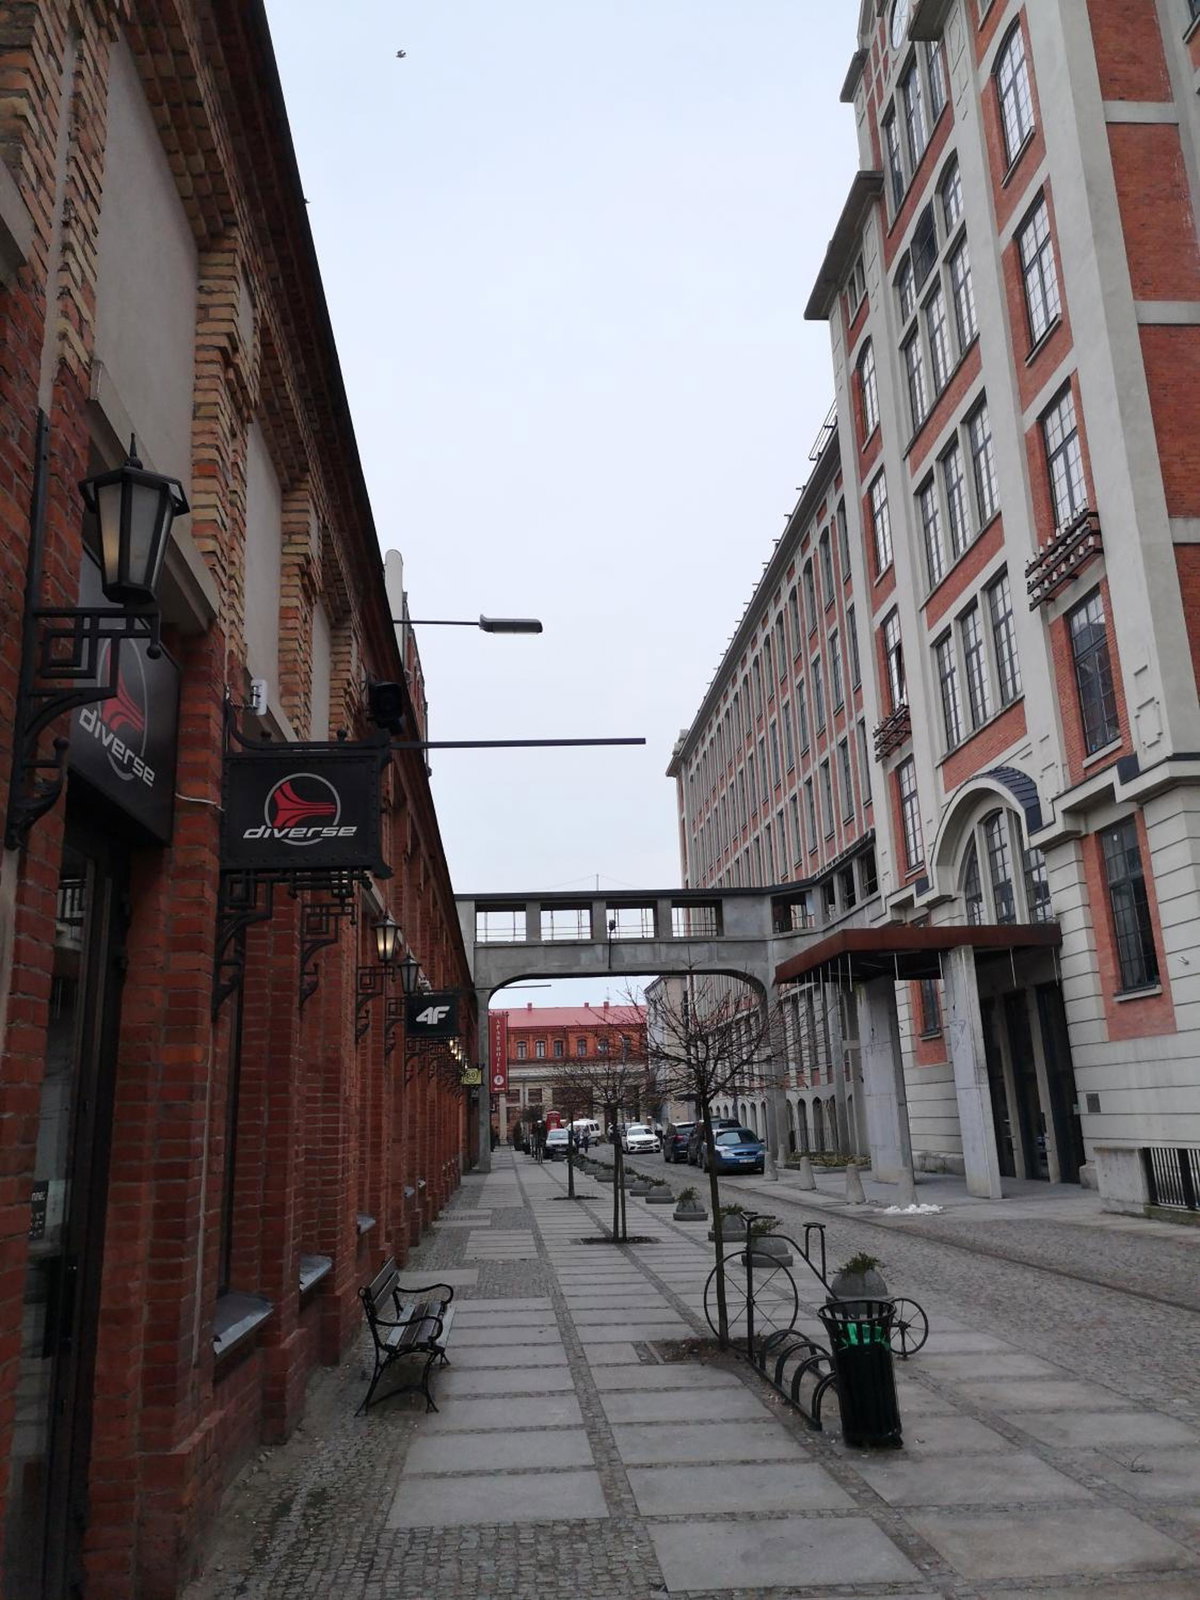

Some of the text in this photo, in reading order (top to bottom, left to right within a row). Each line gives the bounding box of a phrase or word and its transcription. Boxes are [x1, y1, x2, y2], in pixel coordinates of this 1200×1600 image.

[79, 708, 155, 787] diverse
[243, 825, 358, 839] diverse
[416, 1006, 450, 1024] 4F
